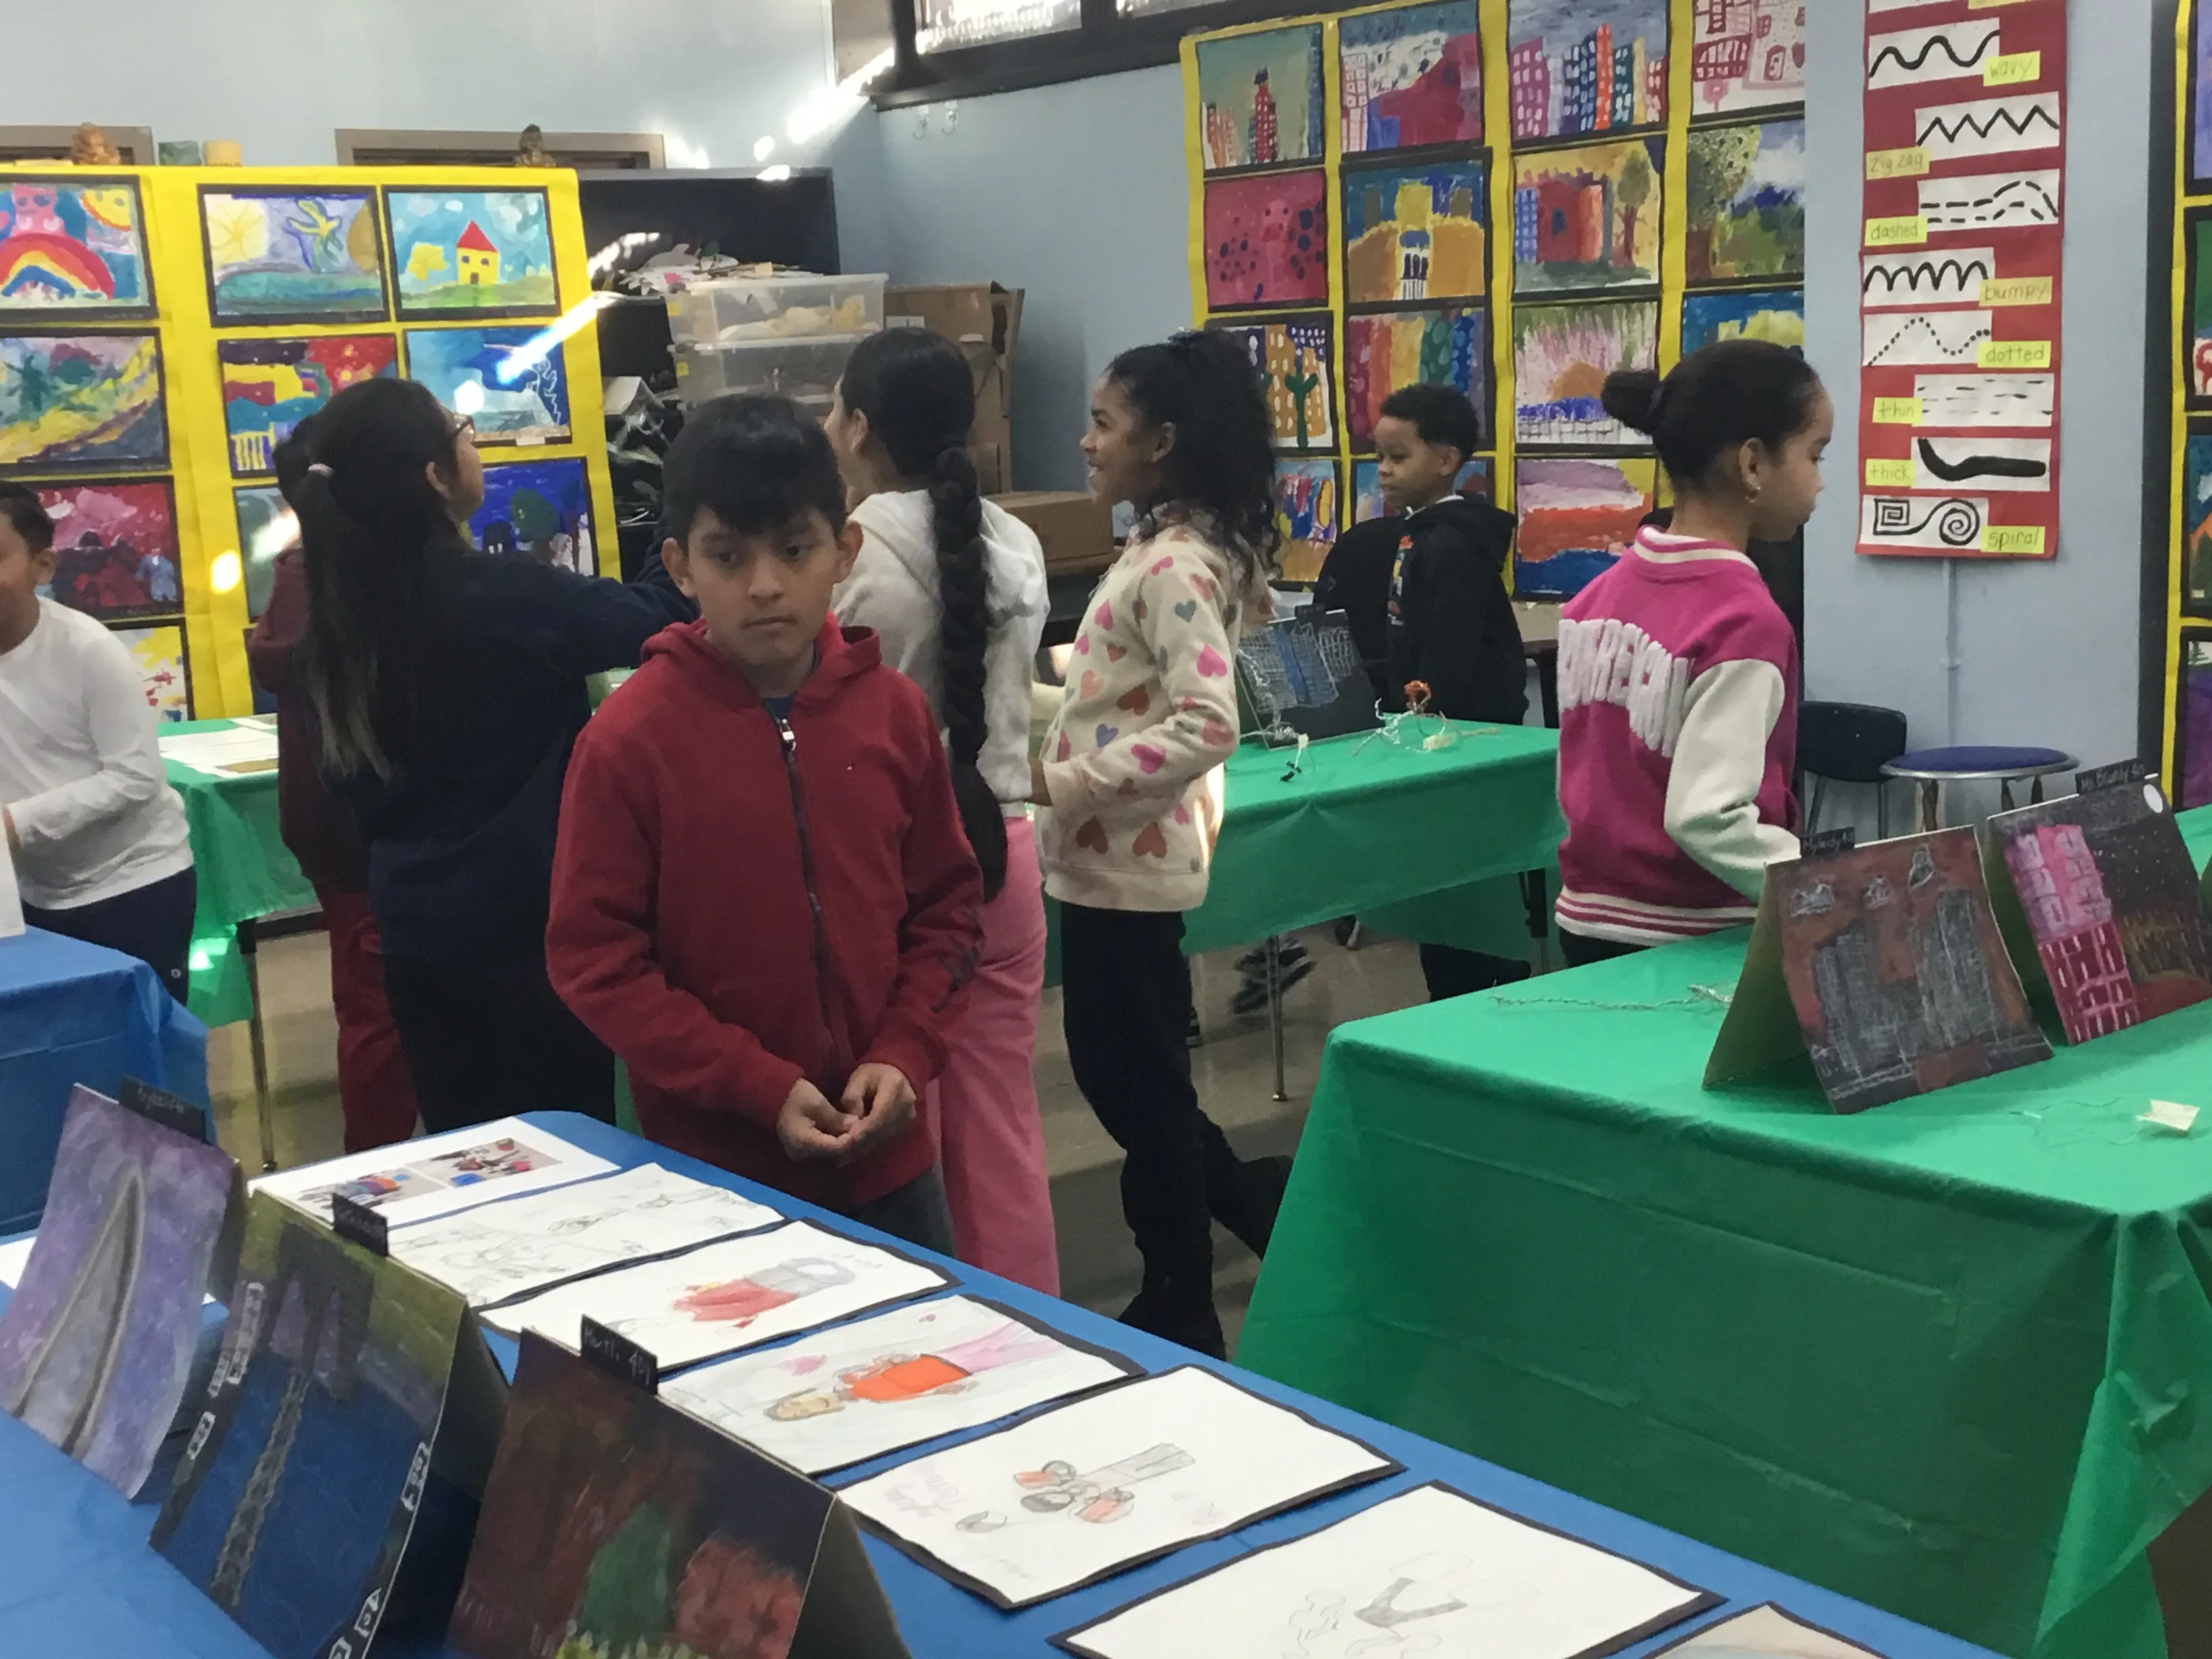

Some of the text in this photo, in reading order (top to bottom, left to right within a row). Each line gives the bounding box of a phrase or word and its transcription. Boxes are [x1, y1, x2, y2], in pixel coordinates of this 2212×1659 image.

[1989, 58, 2033, 81] wavy
[1897, 152, 1923, 171] zag
[1870, 220, 1918, 241] dashed
[1984, 281, 2048, 302] bumpy
[1985, 344, 2045, 363] dotted
[1878, 400, 1914, 418] thin
[1870, 463, 1909, 480] thick
[1987, 526, 2040, 551] spiral
